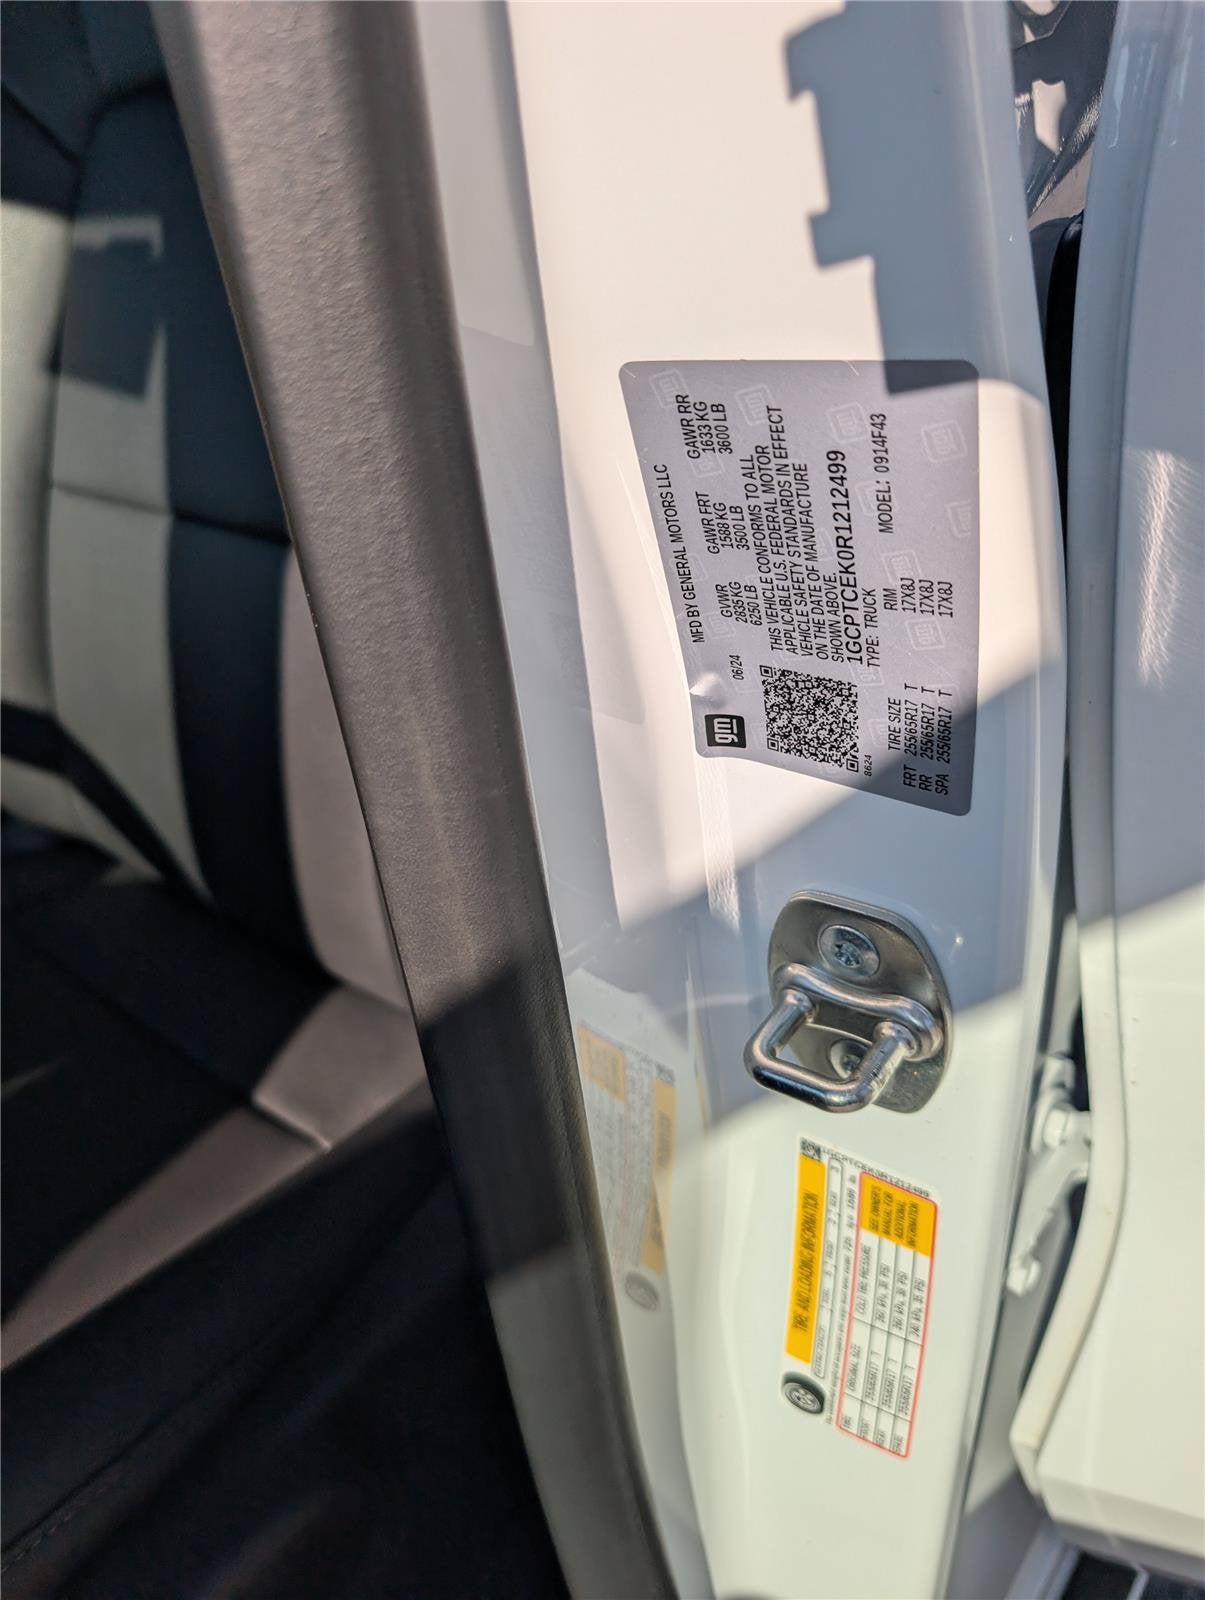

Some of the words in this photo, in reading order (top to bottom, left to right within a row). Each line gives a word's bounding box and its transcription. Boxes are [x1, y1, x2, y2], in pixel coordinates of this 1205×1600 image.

[675, 394, 692, 414] RR
[693, 402, 709, 421] KG
[711, 404, 727, 422] LB
[680, 418, 700, 459] GAWR
[698, 424, 715, 453] 1633
[714, 425, 733, 454] 3600
[766, 405, 788, 459] EFFECT
[870, 414, 889, 473] 0914F43
[654, 464, 671, 488] LLC
[739, 455, 756, 479] ALL
[755, 445, 775, 494] MOTOR
[775, 464, 790, 476] IN
[695, 491, 712, 514] FRT
[744, 484, 760, 500] TO
[660, 492, 684, 543] MOTORS
[713, 503, 728, 520] KG
[729, 506, 744, 521] LB
[778, 481, 800, 558] STANDARDS
[792, 463, 818, 562] MANUFACTURE
[876, 481, 893, 533] MODEL:
[701, 518, 720, 554] GAWR
[716, 522, 734, 548] 1588
[732, 524, 749, 550] 3500
[748, 505, 771, 573] CONFORMS
[764, 498, 784, 556] FEDERAL
[773, 560, 788, 581] U.S.
[826, 451, 862, 664] 1GCPTCEK0R1212499
[673, 546, 696, 600] GENERAL
[789, 561, 807, 606] SAFETY
[806, 565, 820, 581] OF
[715, 584, 732, 618] GVWR
[729, 582, 741, 598] KG
[744, 585, 758, 600] LB
[760, 576, 779, 624] VEHICLE
[808, 584, 824, 615] DATE
[823, 573, 840, 617] ABOVE.
[883, 588, 897, 611] RIM
[900, 578, 916, 613] 17X8J
[919, 579, 934, 615] 17X8J
[938, 582, 952, 618] 17X8J
[685, 604, 700, 617] BY
[732, 600, 748, 623] 2835
[747, 602, 762, 625] 6250
[776, 584, 798, 654] APPLICABLE
[862, 588, 878, 628] TRUCK
[689, 621, 704, 643] MFD
[768, 627, 782, 651] THIS
[796, 609, 813, 656] VEHICLE
[812, 618, 826, 639] THE
[828, 620, 844, 662] SHOWN
[815, 643, 828, 659] ON
[866, 636, 880, 667] TYPE:
[729, 655, 744, 680] 06/24
[888, 698, 900, 723] SIZE
[714, 718, 738, 743] gm
[888, 725, 901, 750] TIRE
[905, 699, 918, 756] 255/65R17
[921, 703, 934, 759] 255/65R17
[938, 706, 952, 764] 255/65R17
[864, 755, 872, 776] 8624
[903, 764, 916, 788] FRT
[919, 775, 932, 792] RR
[935, 774, 949, 795] SPA
[800, 1190, 818, 1253] INFORMATION
[798, 1253, 814, 1296] LOADING
[793, 1312, 808, 1332] TIRE
